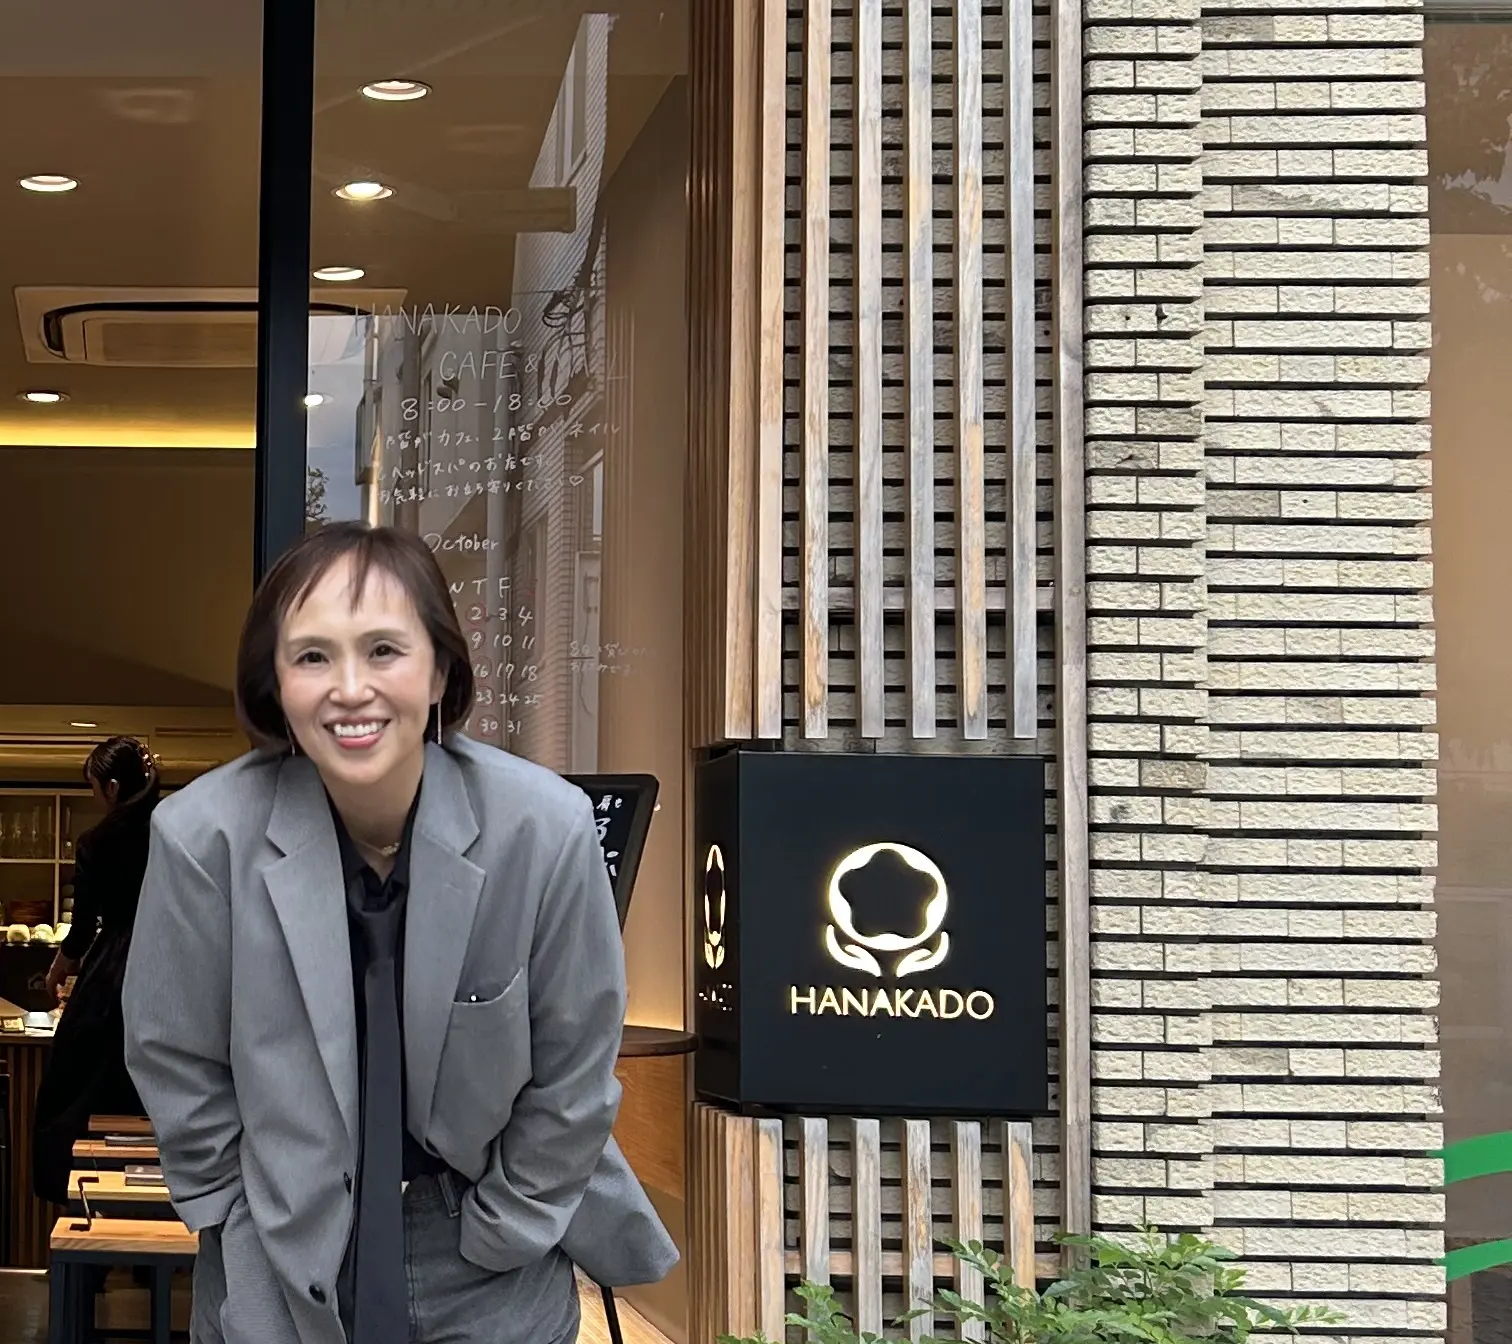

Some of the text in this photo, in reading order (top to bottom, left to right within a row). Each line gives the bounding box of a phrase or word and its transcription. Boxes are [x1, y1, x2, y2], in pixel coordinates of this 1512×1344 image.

[354, 303, 522, 337] HANAKADO
[439, 350, 517, 382] CAFE
[524, 354, 538, 373] &
[424, 532, 499, 554] October
[471, 577, 488, 596] T
[498, 576, 511, 599] F
[470, 605, 534, 628] 2 3 4
[471, 631, 536, 650] 9 10 11
[473, 663, 538, 682] 16 17 18
[475, 690, 543, 708] 23 24 25
[480, 718, 499, 733] 30
[506, 719, 522, 735] 31
[790, 984, 995, 1021] HANAKADO
